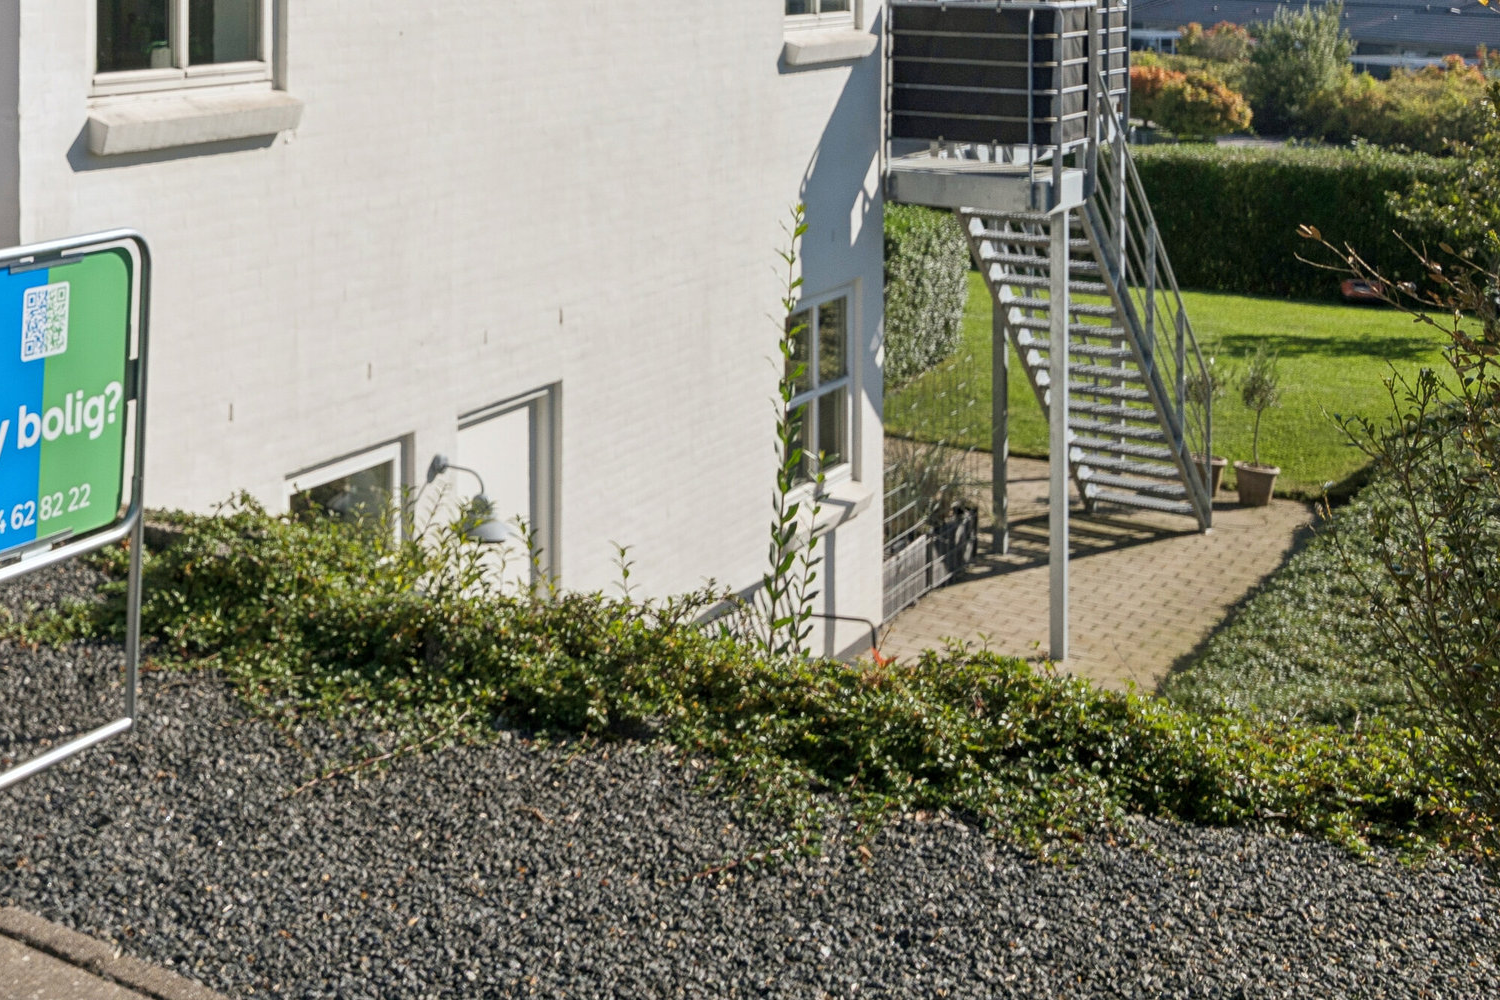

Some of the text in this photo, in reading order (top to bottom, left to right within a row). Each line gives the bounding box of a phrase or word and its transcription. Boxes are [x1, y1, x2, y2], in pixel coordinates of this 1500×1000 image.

[17, 381, 123, 449] bolig?
[10, 500, 36, 531] 62
[40, 491, 63, 522] 82
[68, 483, 91, 512] 22
